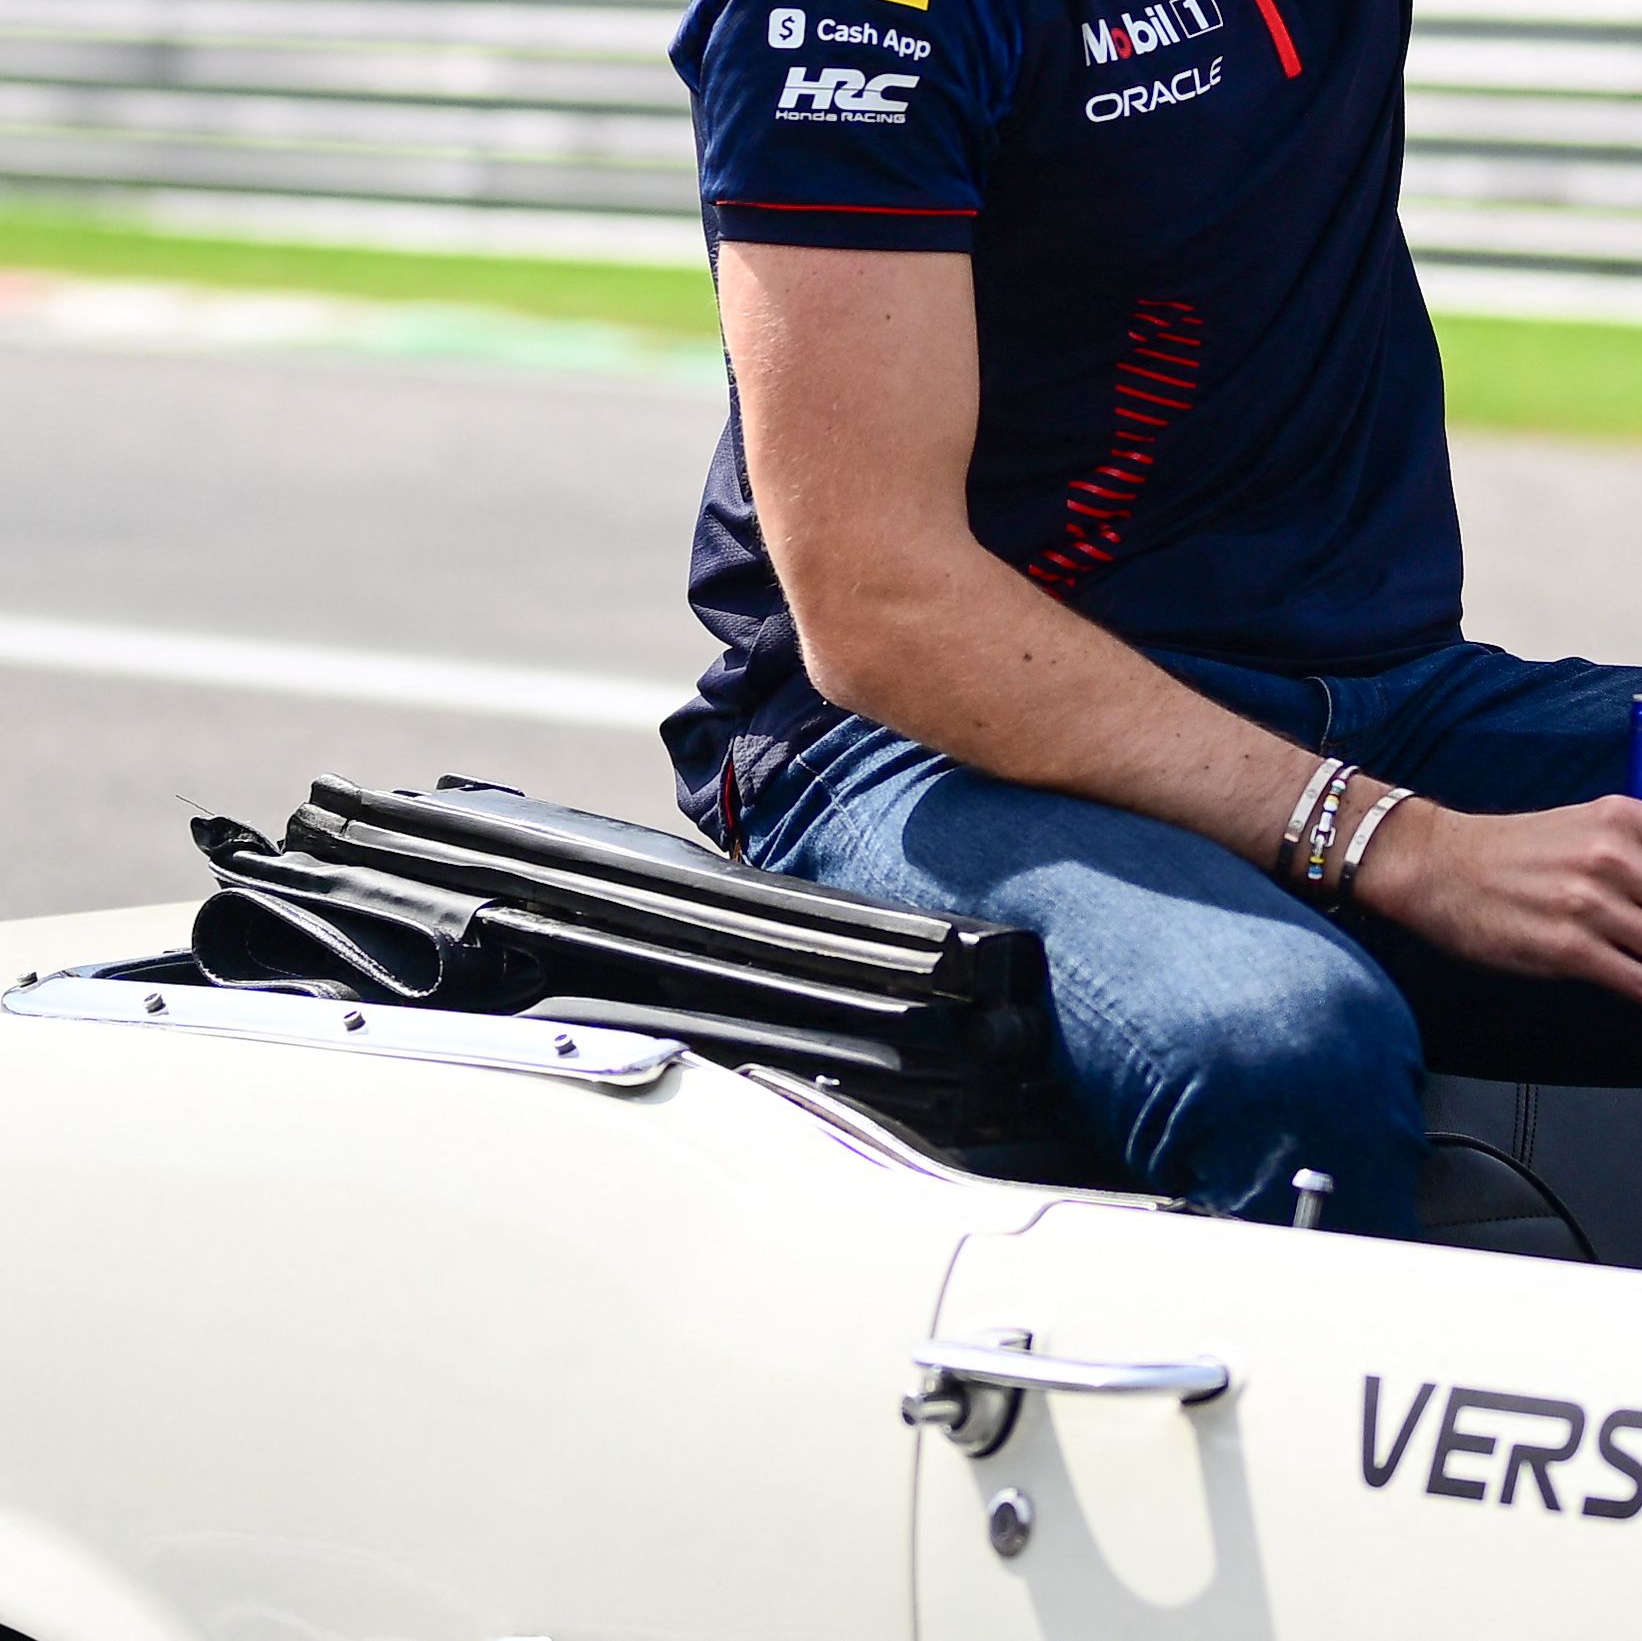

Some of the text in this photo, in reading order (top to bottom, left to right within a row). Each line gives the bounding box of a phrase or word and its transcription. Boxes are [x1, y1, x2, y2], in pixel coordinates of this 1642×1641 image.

[816, 18, 879, 46] Cash
[882, 29, 932, 62] App
[1081, 3, 1181, 68] Mobil
[777, 66, 921, 113] HRC
[1085, 55, 1224, 124] ORACLE
[775, 110, 907, 125] Honda RACING
